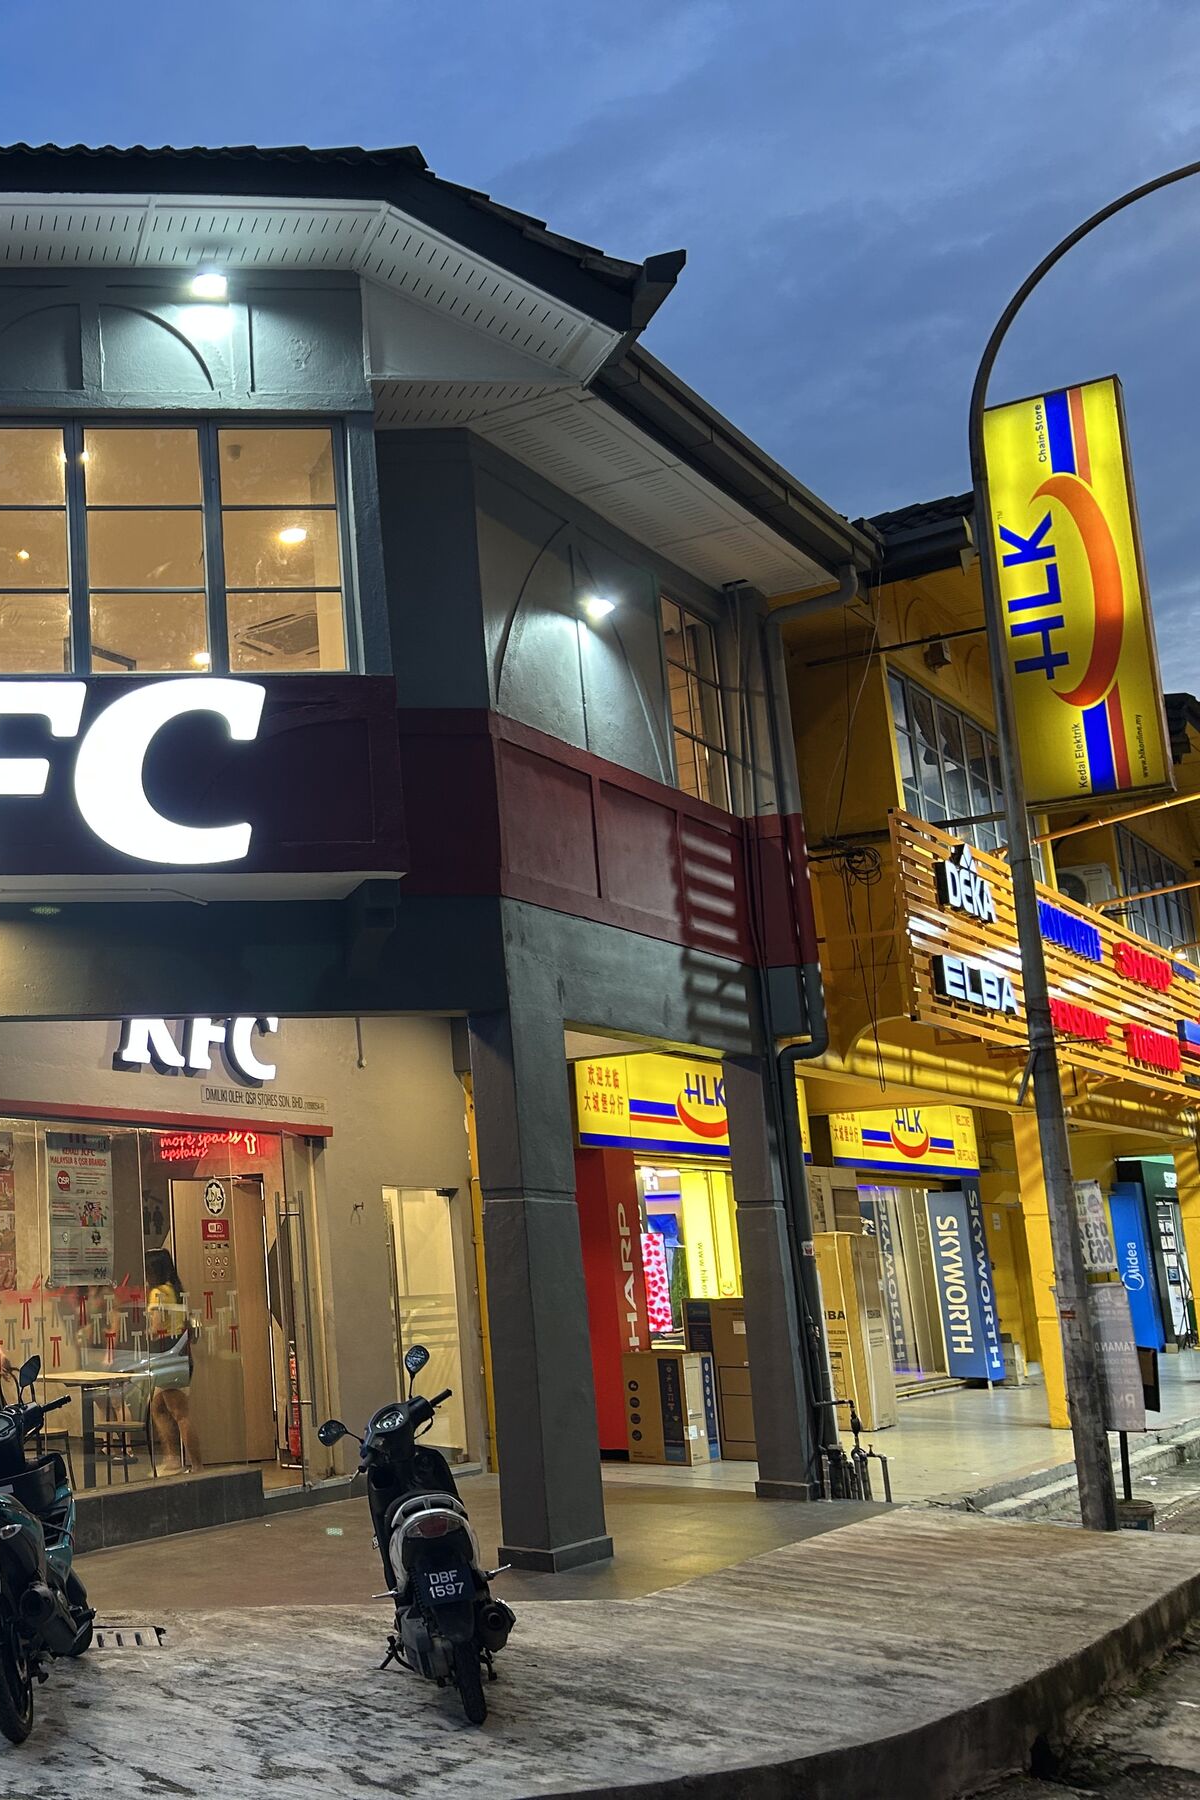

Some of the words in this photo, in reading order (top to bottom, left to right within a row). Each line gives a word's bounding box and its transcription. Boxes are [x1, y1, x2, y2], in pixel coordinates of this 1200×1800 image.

[1037, 403, 1048, 463] Chain-Store
[999, 510, 1070, 681] HLK
[1072, 721, 1086, 756] Elektrik
[1133, 713, 1150, 779] www.hlkonline.my
[1077, 756, 1089, 789] Kedai
[945, 860, 997, 924] DEKA
[1114, 940, 1174, 994] SHARP
[942, 954, 1020, 1016] ELBA
[587, 1064, 620, 1089] 欢迎光临
[684, 1072, 726, 1107] HLK
[205, 1087, 228, 1102] DIMILIKI
[245, 1091, 257, 1105] QSR
[257, 1093, 278, 1107] STORES
[584, 1091, 624, 1116] 大城堡分行
[895, 1107, 923, 1134] HLK
[160, 1133, 195, 1148] more
[161, 1145, 208, 1162] upstairs
[617, 1202, 640, 1353] HARP
[968, 1189, 1001, 1369] SKYWORTH
[1123, 1242, 1143, 1286] Midea
[935, 1215, 975, 1355] SKYWORTH
[428, 1569, 458, 1585] DBF
[428, 1581, 465, 1599] 1597
